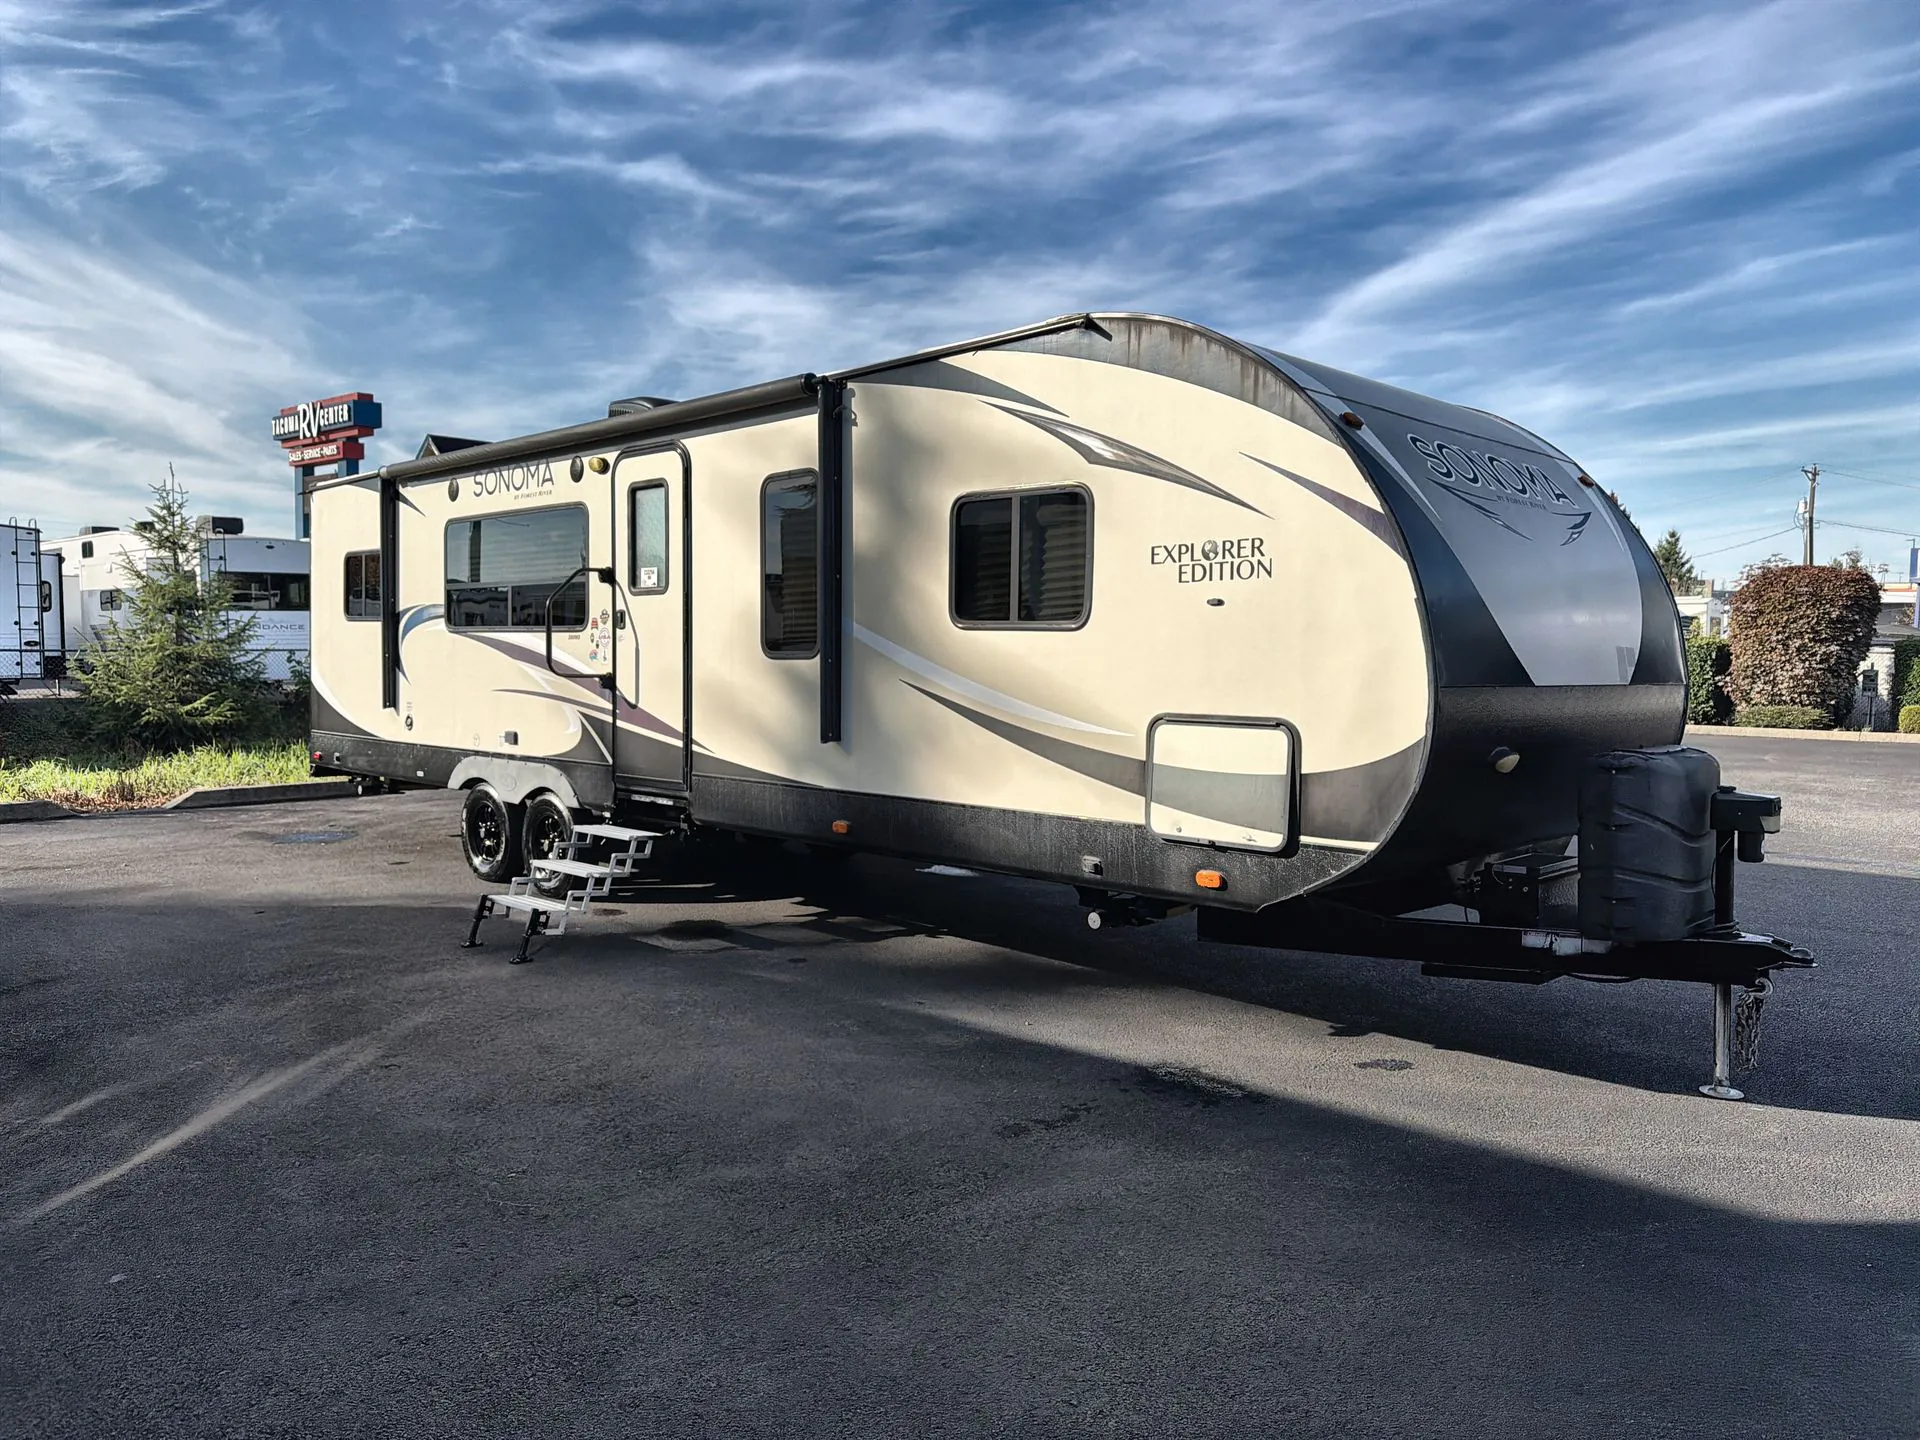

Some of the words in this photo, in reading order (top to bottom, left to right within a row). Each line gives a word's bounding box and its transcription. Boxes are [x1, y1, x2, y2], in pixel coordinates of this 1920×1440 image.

[272, 415, 299, 435] TACOMA
[297, 401, 320, 440] RV
[320, 404, 348, 426] CENTER
[473, 457, 555, 498] SONOMA
[1406, 433, 1580, 509] SONOMA
[1150, 537, 1266, 565] EXPLORER
[1178, 558, 1273, 584] EDITION
